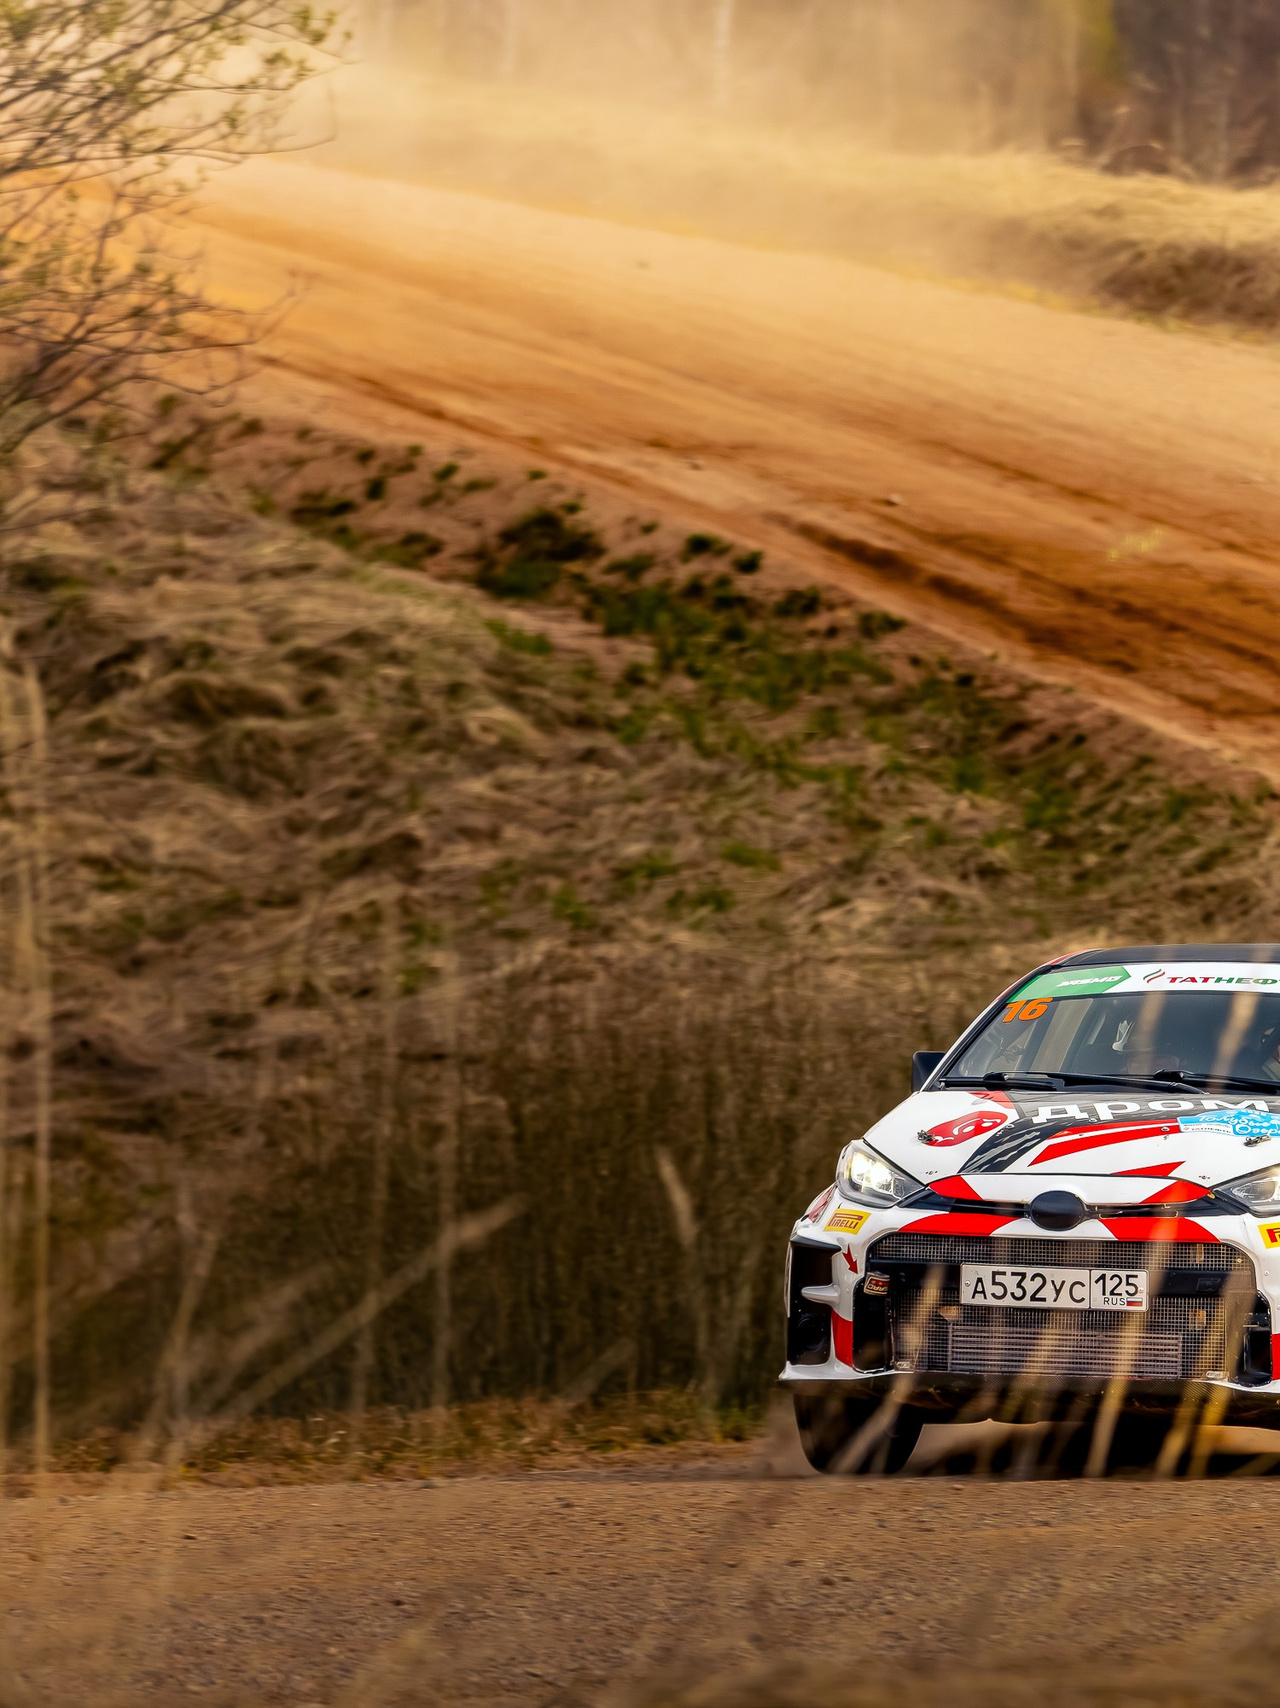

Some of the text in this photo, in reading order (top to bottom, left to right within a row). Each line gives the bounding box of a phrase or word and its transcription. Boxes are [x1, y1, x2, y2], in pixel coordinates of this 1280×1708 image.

[1003, 998, 1053, 1023] 16
[828, 1212, 864, 1230] PIRELLI
[1094, 1273, 1138, 1297] 125
[1103, 1297, 1126, 1306] RUS
